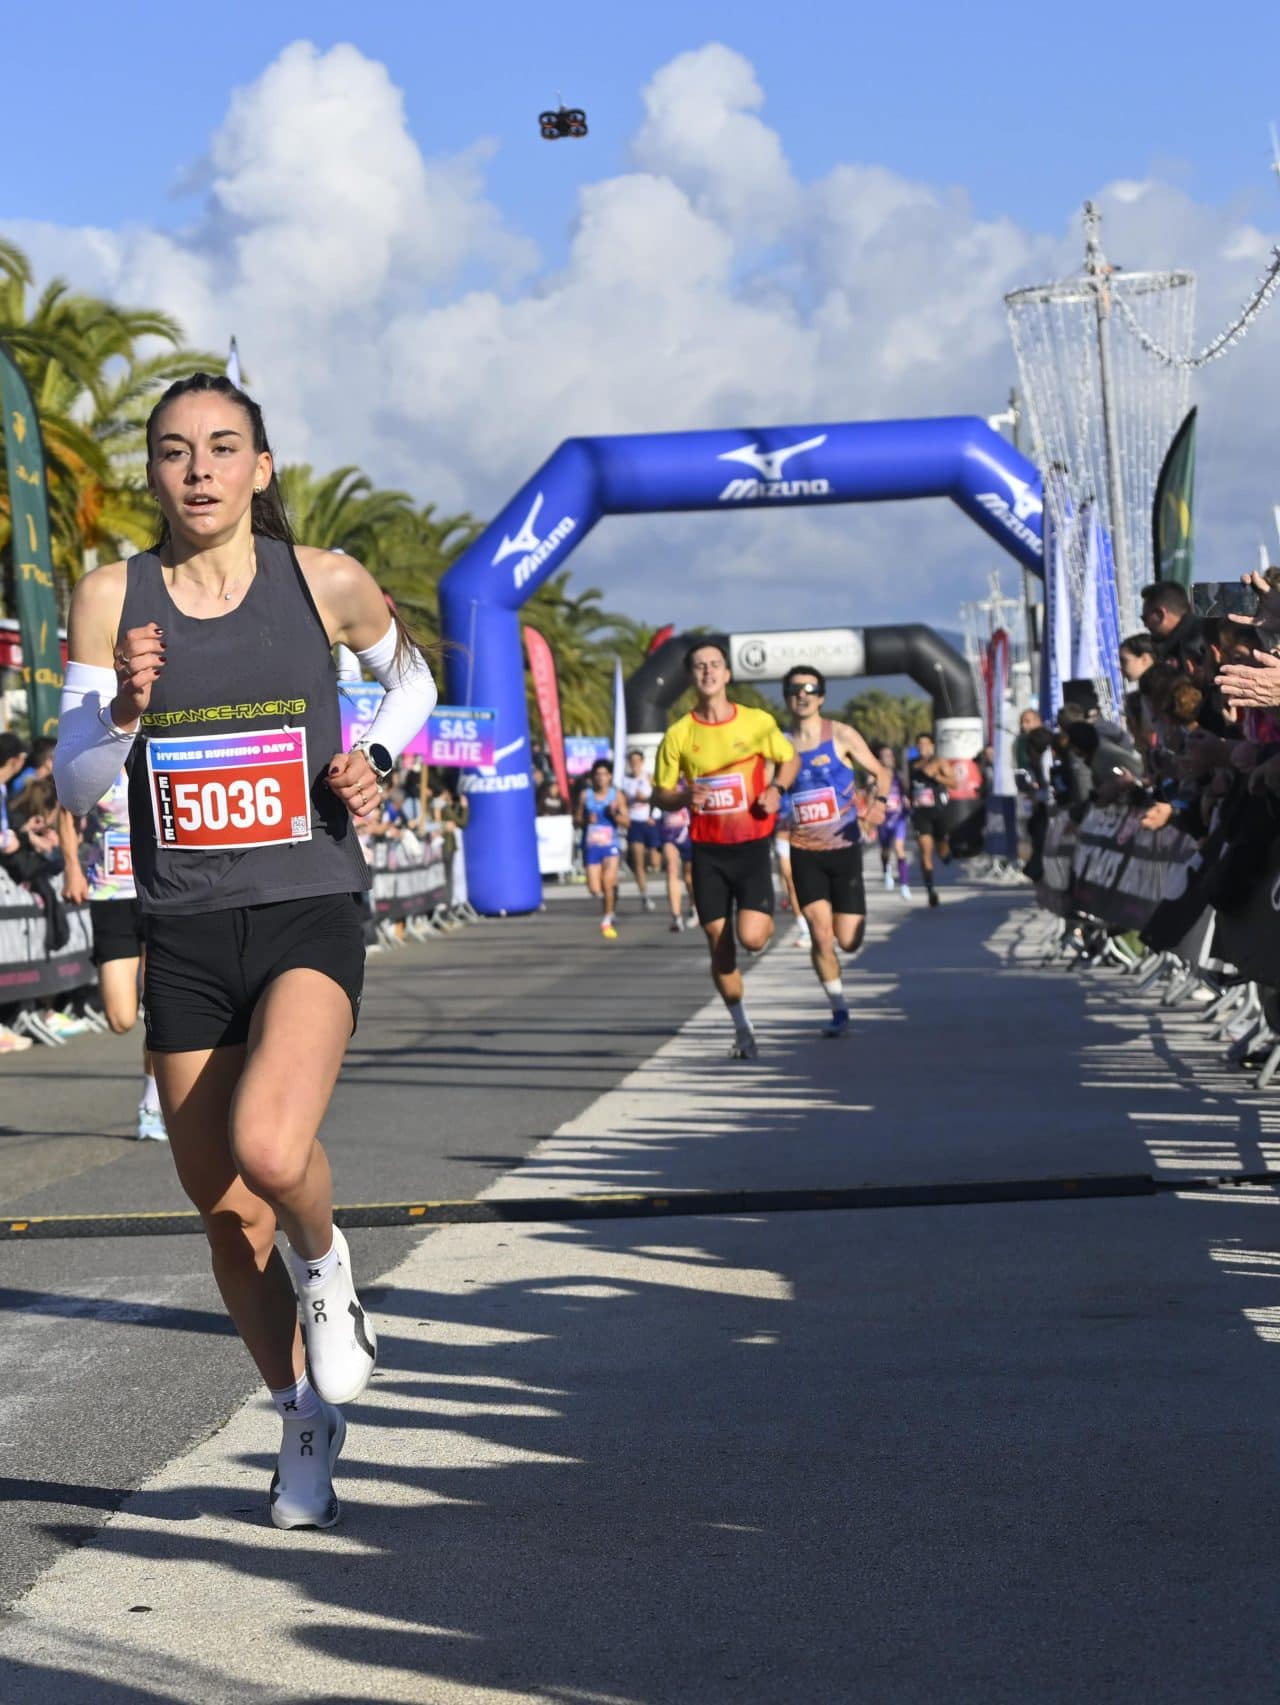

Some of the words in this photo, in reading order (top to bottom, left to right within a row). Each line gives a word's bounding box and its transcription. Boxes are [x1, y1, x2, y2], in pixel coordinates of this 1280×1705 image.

[439, 719, 478, 740] SAS
[432, 739, 483, 762] ELITE
[158, 776, 176, 841] ELITE
[175, 777, 283, 832] 5036
